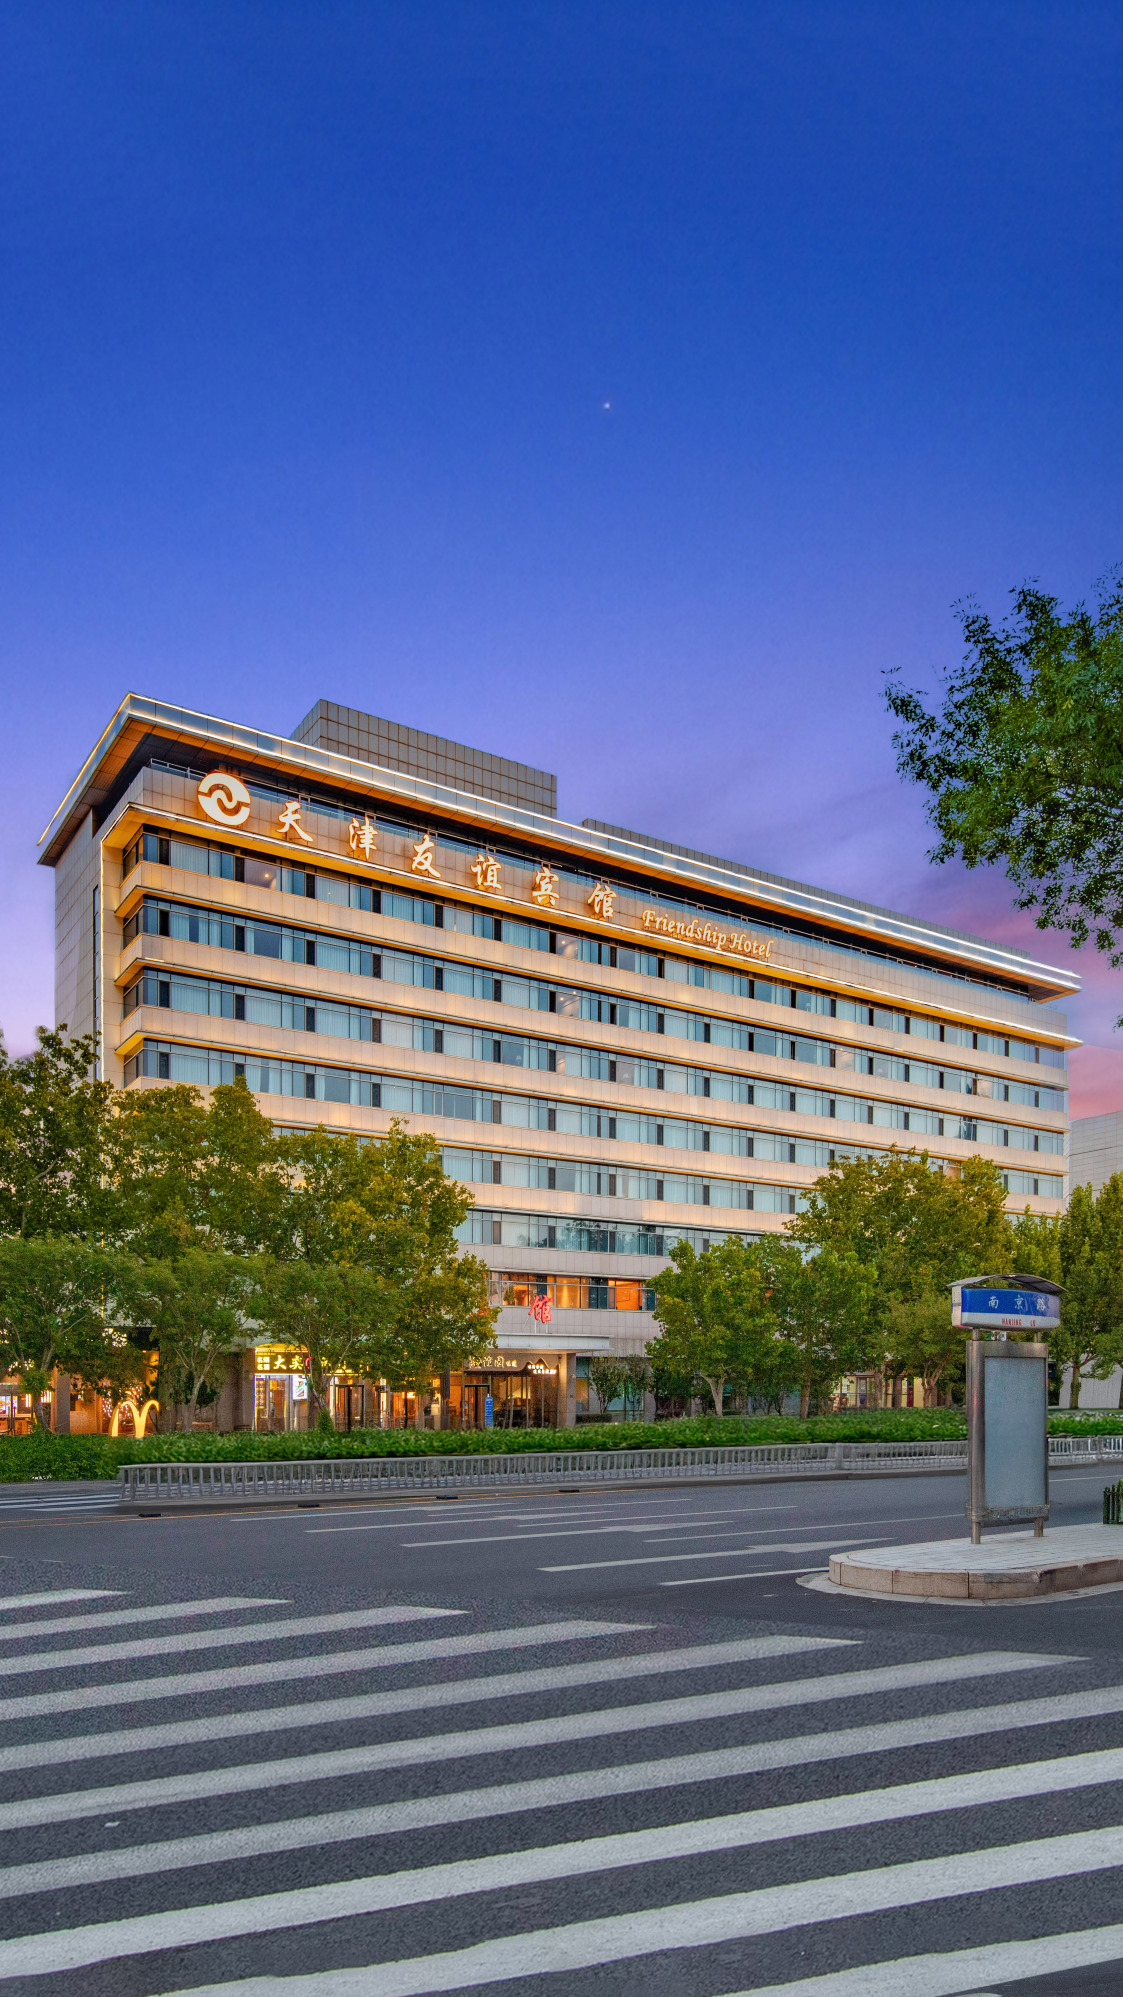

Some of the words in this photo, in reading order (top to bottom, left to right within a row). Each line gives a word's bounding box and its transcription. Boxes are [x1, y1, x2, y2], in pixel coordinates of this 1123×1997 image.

[277, 800, 617, 919] 天津友谊宾馆
[642, 909, 727, 950] Friendship
[729, 932, 774, 957] Hotel
[988, 1295, 1046, 1311] 南京路
